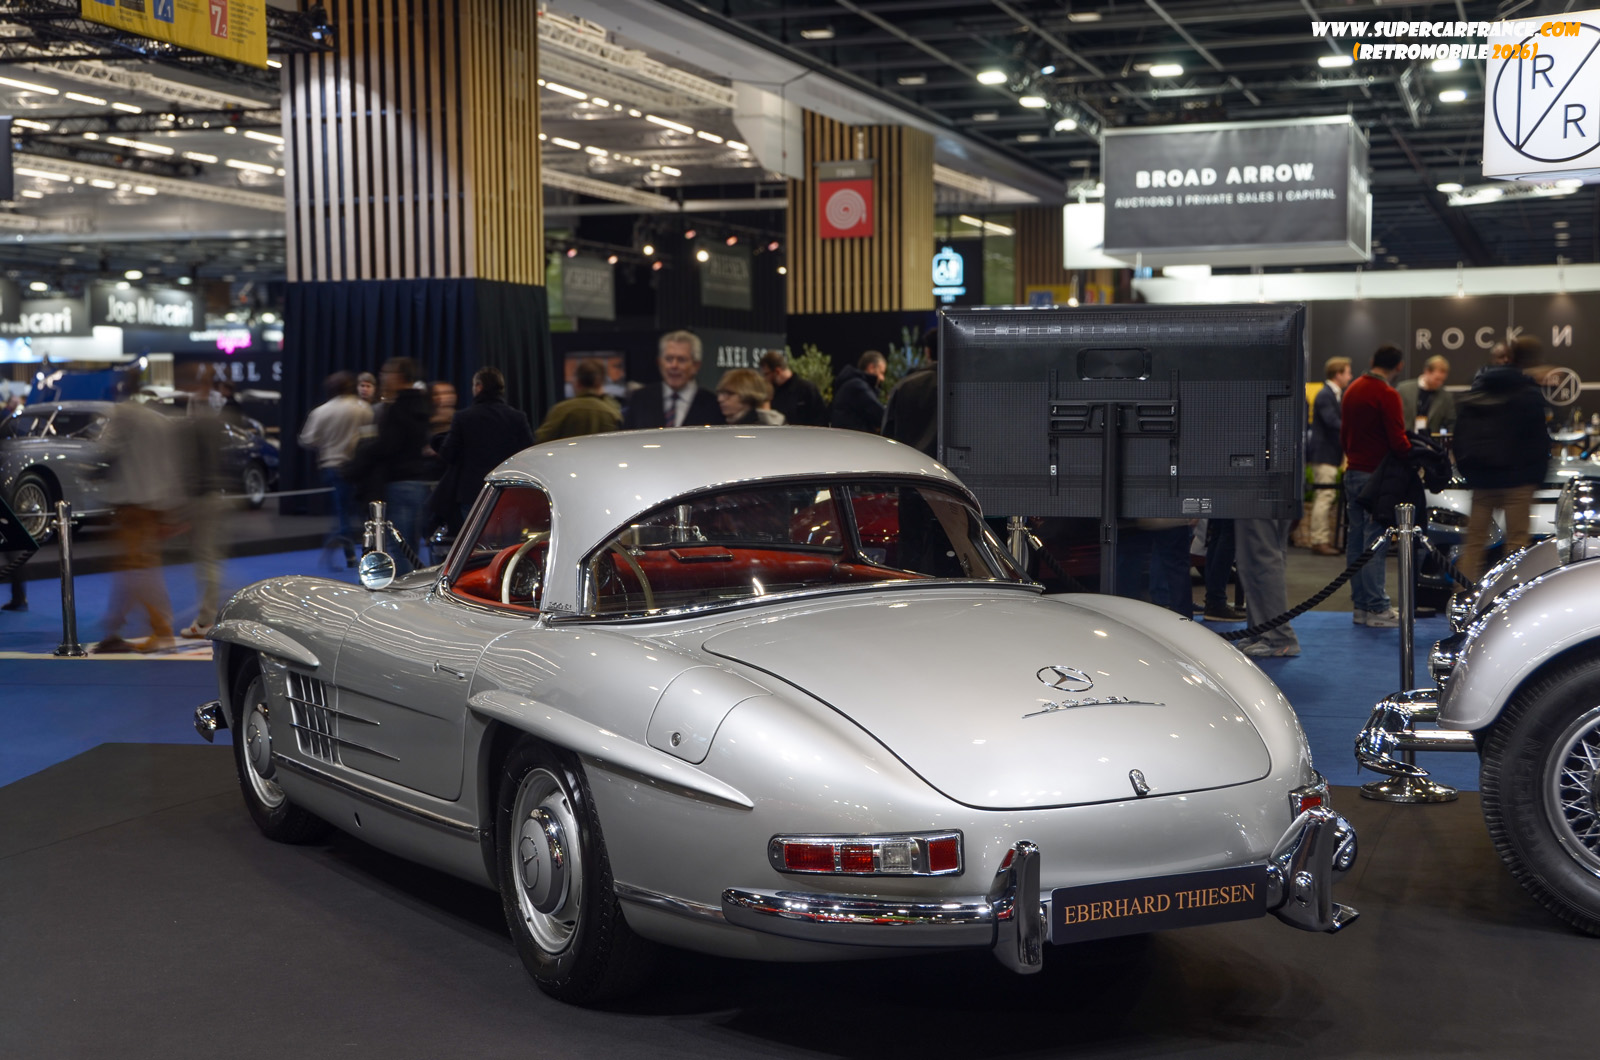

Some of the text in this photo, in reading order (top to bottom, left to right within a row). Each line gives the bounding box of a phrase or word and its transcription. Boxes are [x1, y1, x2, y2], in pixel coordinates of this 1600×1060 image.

[211, 5, 227, 37] 7.2
[1136, 168, 1217, 188] BROAD
[1114, 195, 1175, 209] AUCTIONS
[1185, 192, 1234, 206] PRIVATE
[1236, 190, 1275, 204] SALES
[1285, 188, 1337, 201] CAPITAL
[105, 294, 193, 327] Joe Macari
[1415, 326, 1524, 350] ROCK
[716, 346, 749, 368] AXEL
[1064, 883, 1256, 925] EBERHARD THIESEN
